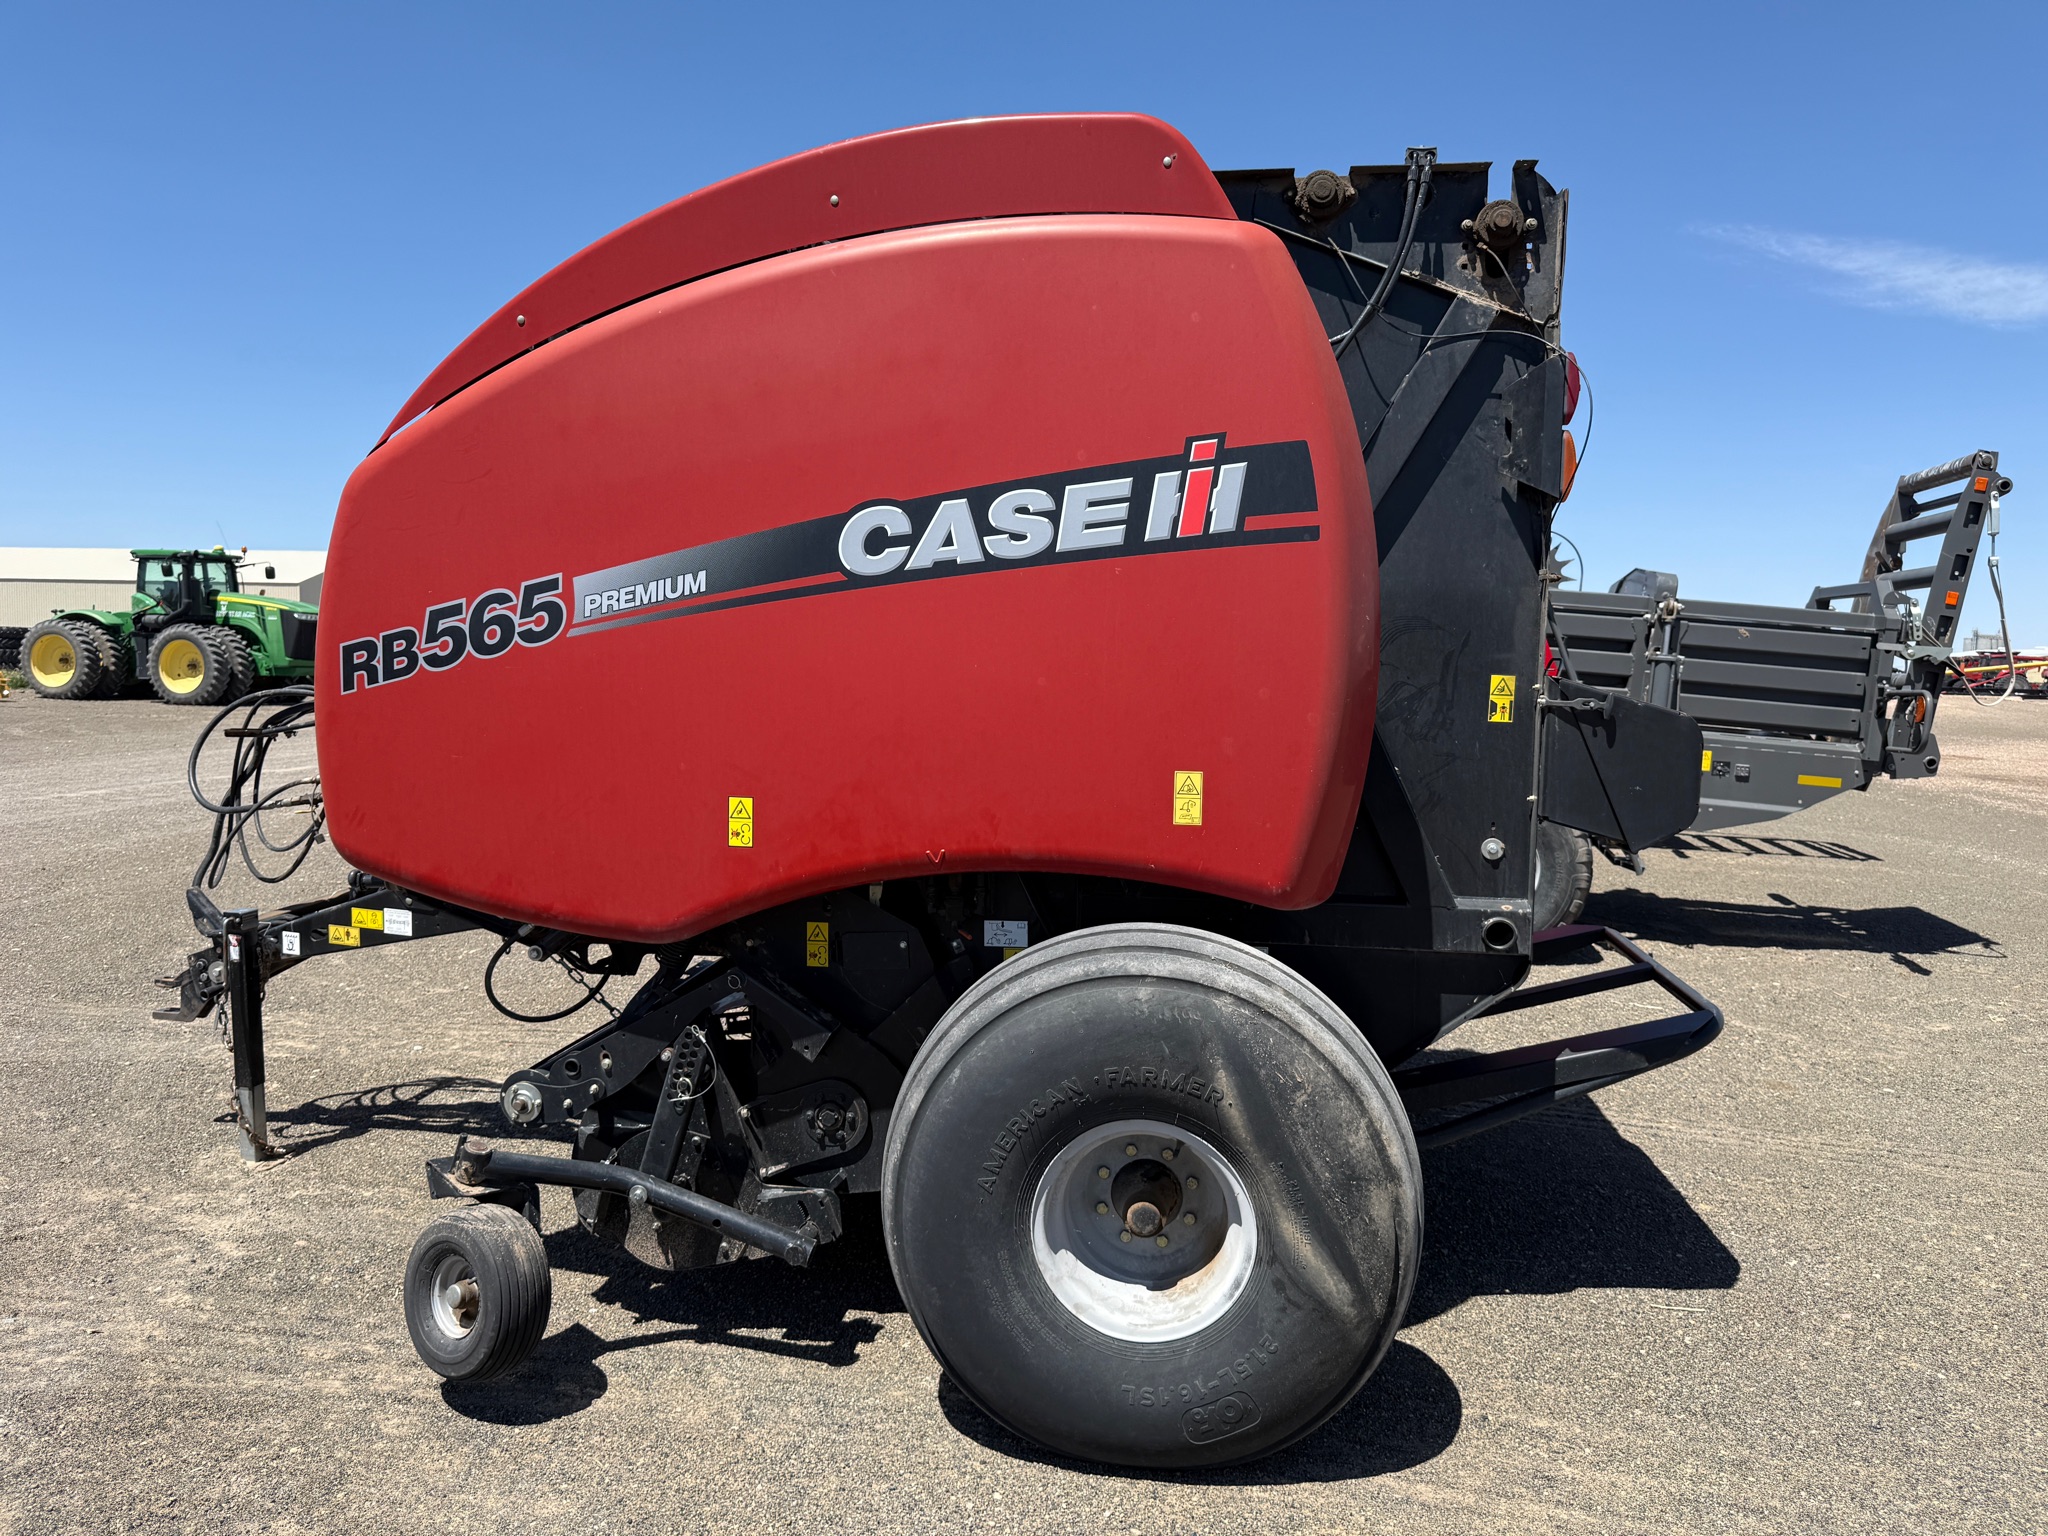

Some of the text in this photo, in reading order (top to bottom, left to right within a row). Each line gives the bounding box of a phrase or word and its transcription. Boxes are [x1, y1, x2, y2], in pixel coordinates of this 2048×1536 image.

[838, 477, 1133, 577] CASE
[340, 570, 707, 695] RB565 PREMIUM
[977, 1066, 1225, 1195] AMERICAN FARMER
